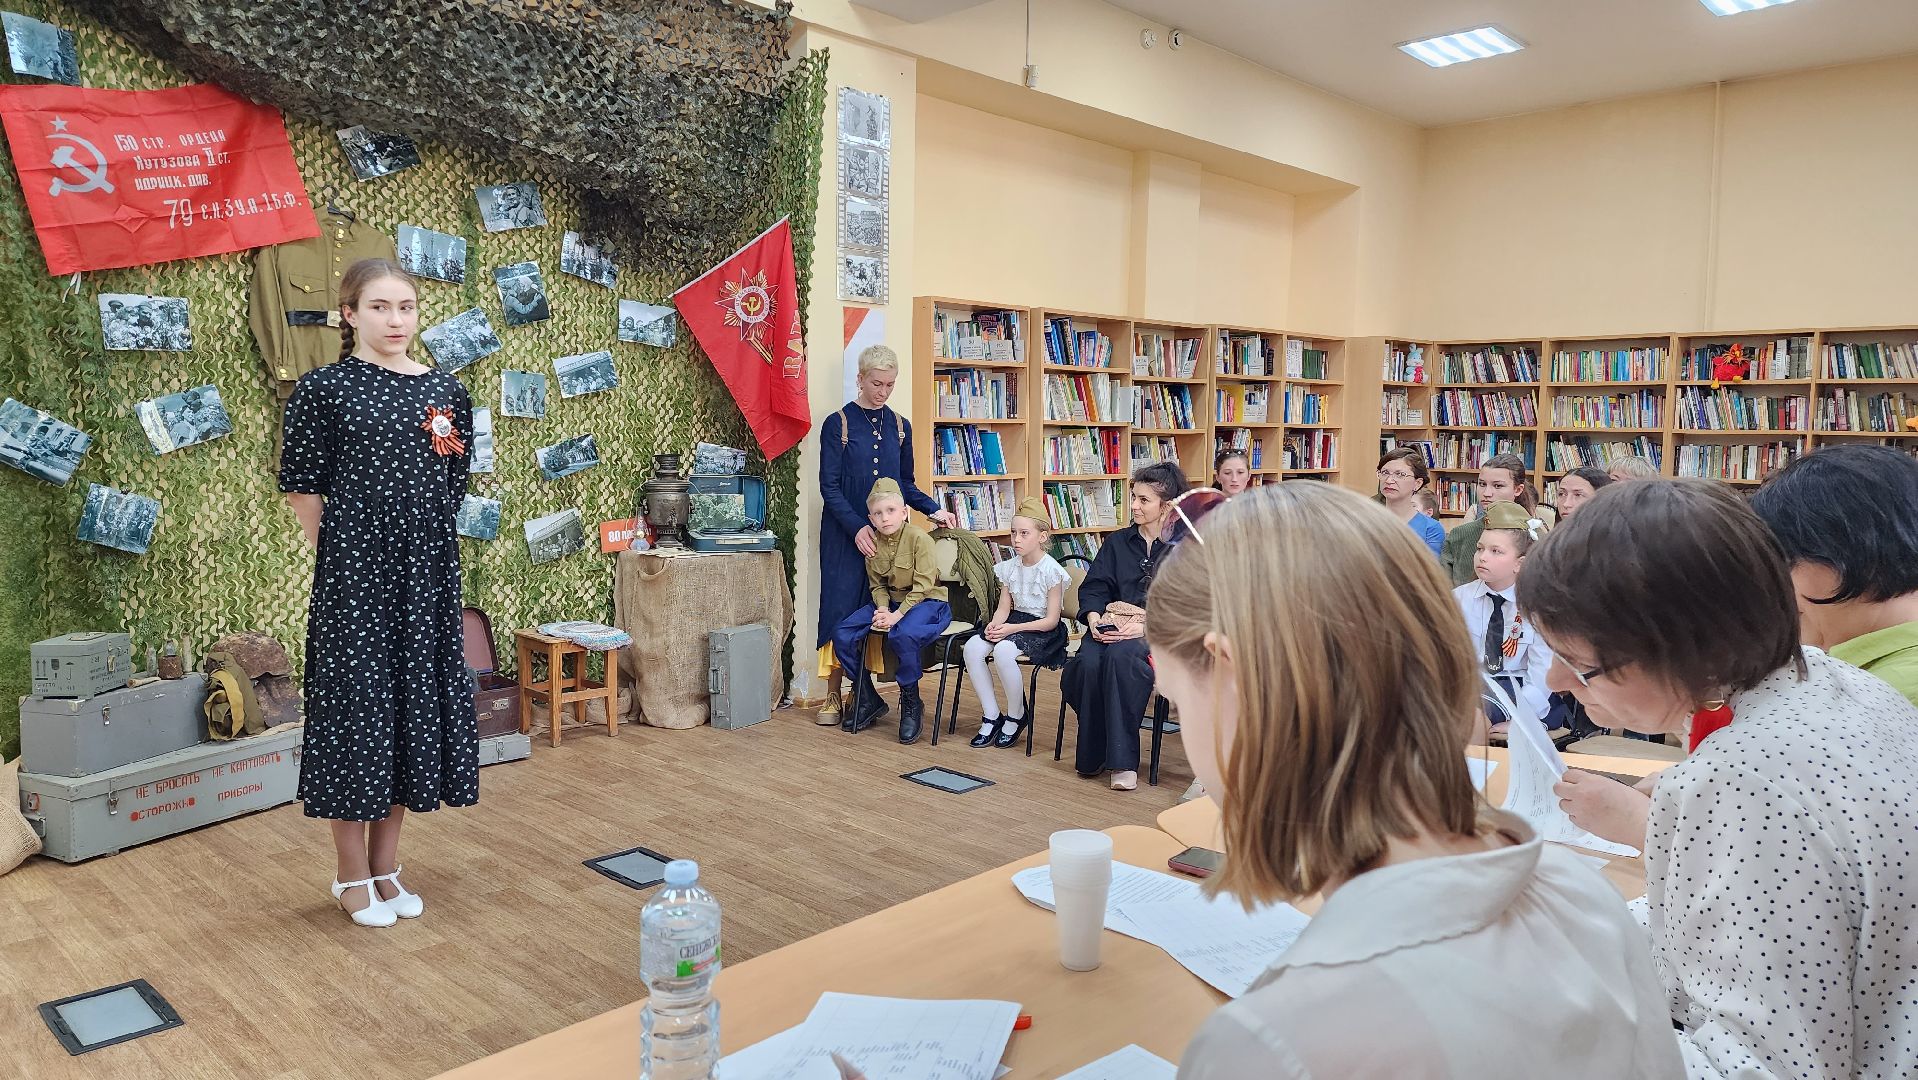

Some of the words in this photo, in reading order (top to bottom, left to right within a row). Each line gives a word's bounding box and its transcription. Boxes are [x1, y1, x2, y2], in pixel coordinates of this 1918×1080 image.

[113, 134, 140, 152] 150
[141, 136, 171, 150] СТР.
[178, 129, 227, 147] ОРДЕНА
[163, 198, 194, 229] 79
[608, 530, 621, 543] 80
[135, 785, 150, 799] НЕ
[155, 772, 200, 794] БРОСАТЬ
[212, 765, 225, 778] НЕ
[230, 751, 281, 774] КАНТОВАТЬ
[217, 782, 263, 802] ПРИБОРЫ
